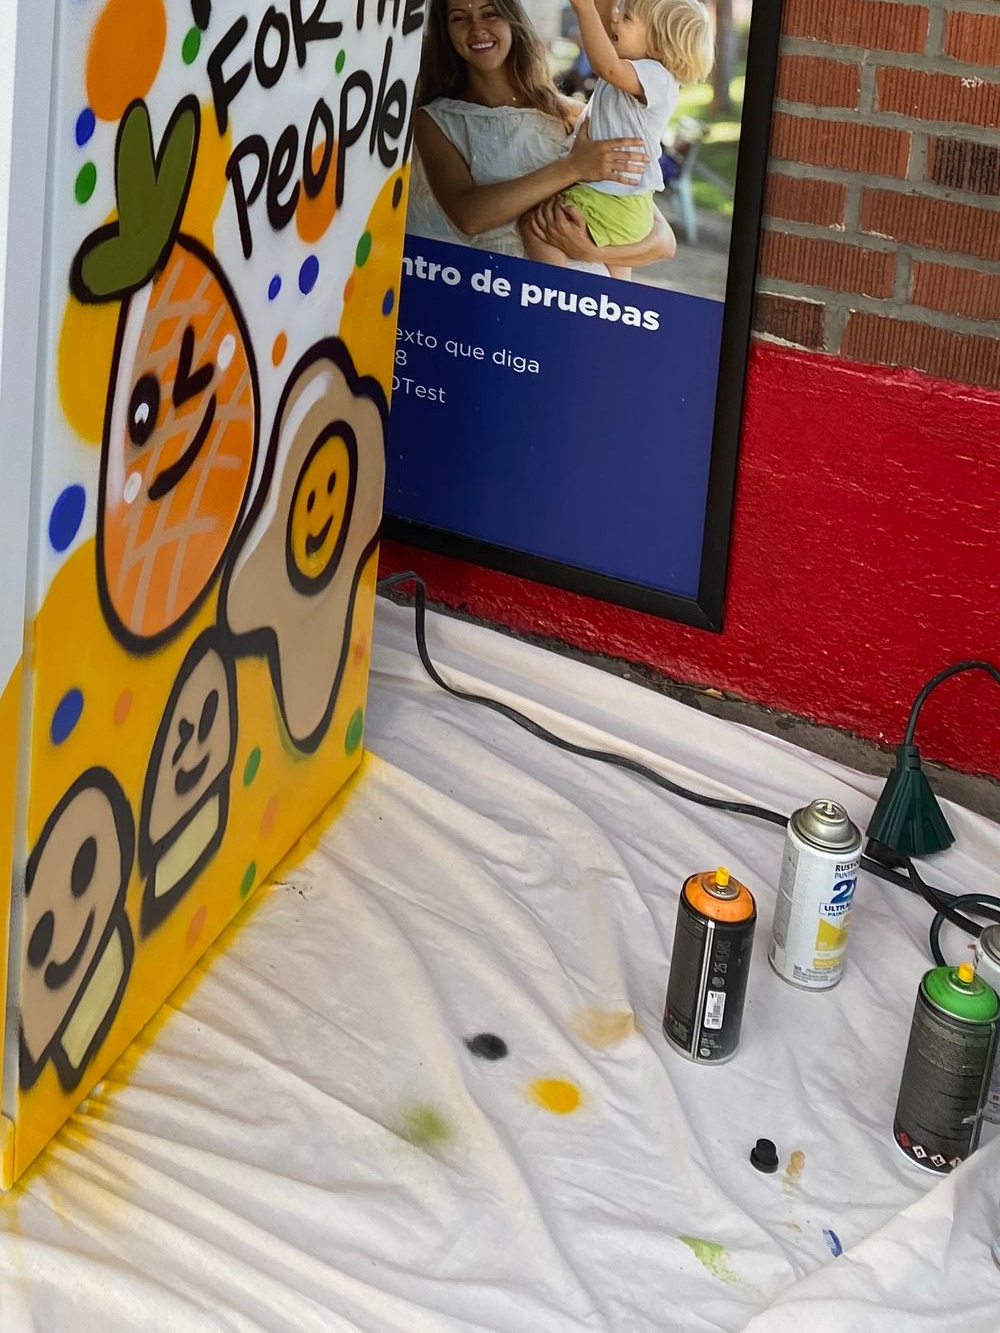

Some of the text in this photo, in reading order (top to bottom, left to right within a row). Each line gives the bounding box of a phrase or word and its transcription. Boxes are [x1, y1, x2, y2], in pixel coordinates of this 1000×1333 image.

[470, 269, 513, 297] de
[520, 280, 661, 331] pruebas
[445, 339, 485, 360] que
[492, 349, 540, 374] diga
[713, 961, 728, 974] 25
